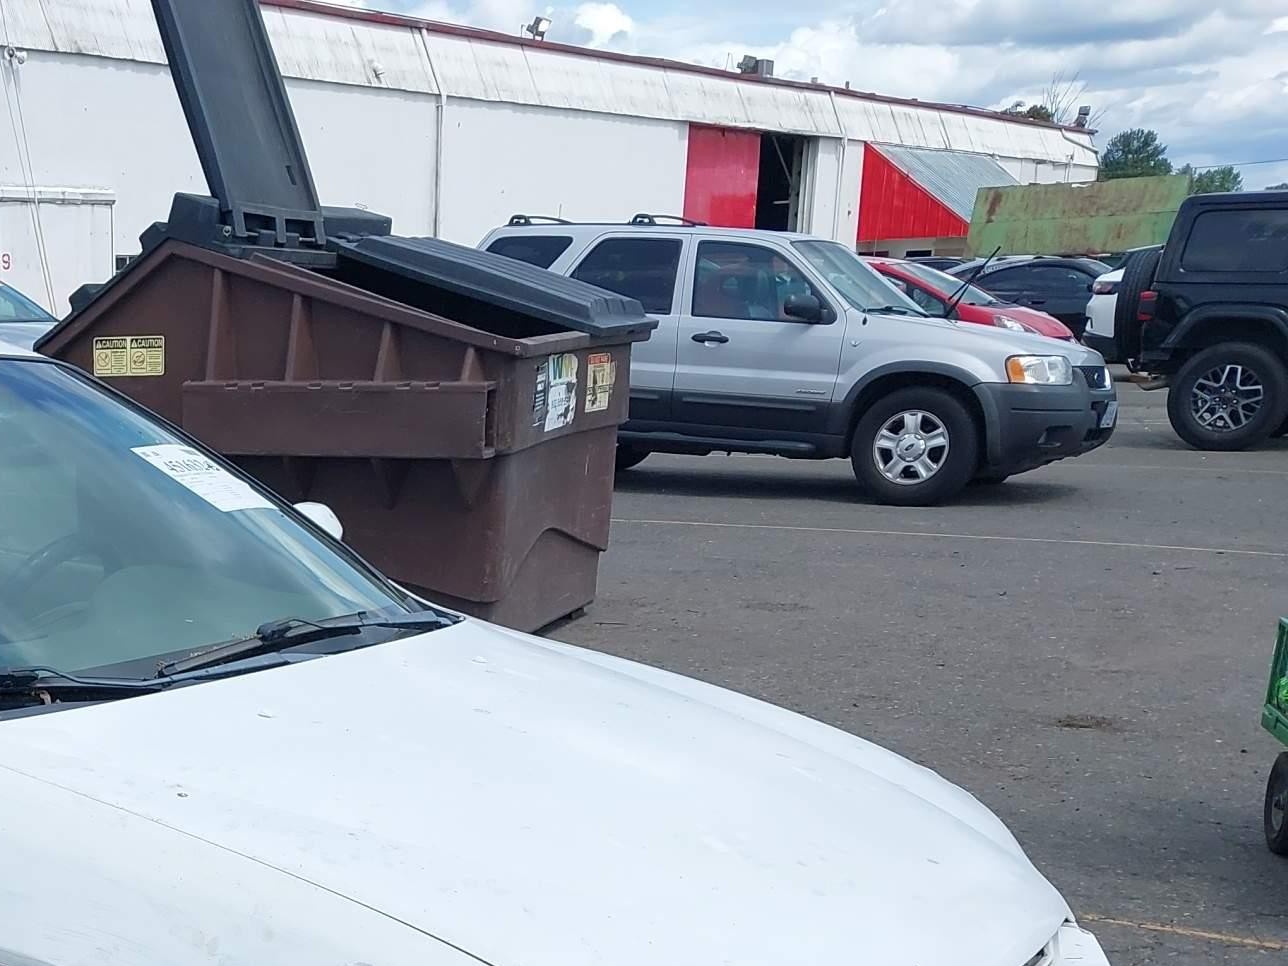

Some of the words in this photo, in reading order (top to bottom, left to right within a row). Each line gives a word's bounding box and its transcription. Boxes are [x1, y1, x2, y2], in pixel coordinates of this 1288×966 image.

[2, 253, 11, 270] 9
[101, 340, 127, 348] CAUTION
[138, 338, 163, 348] CAUTION
